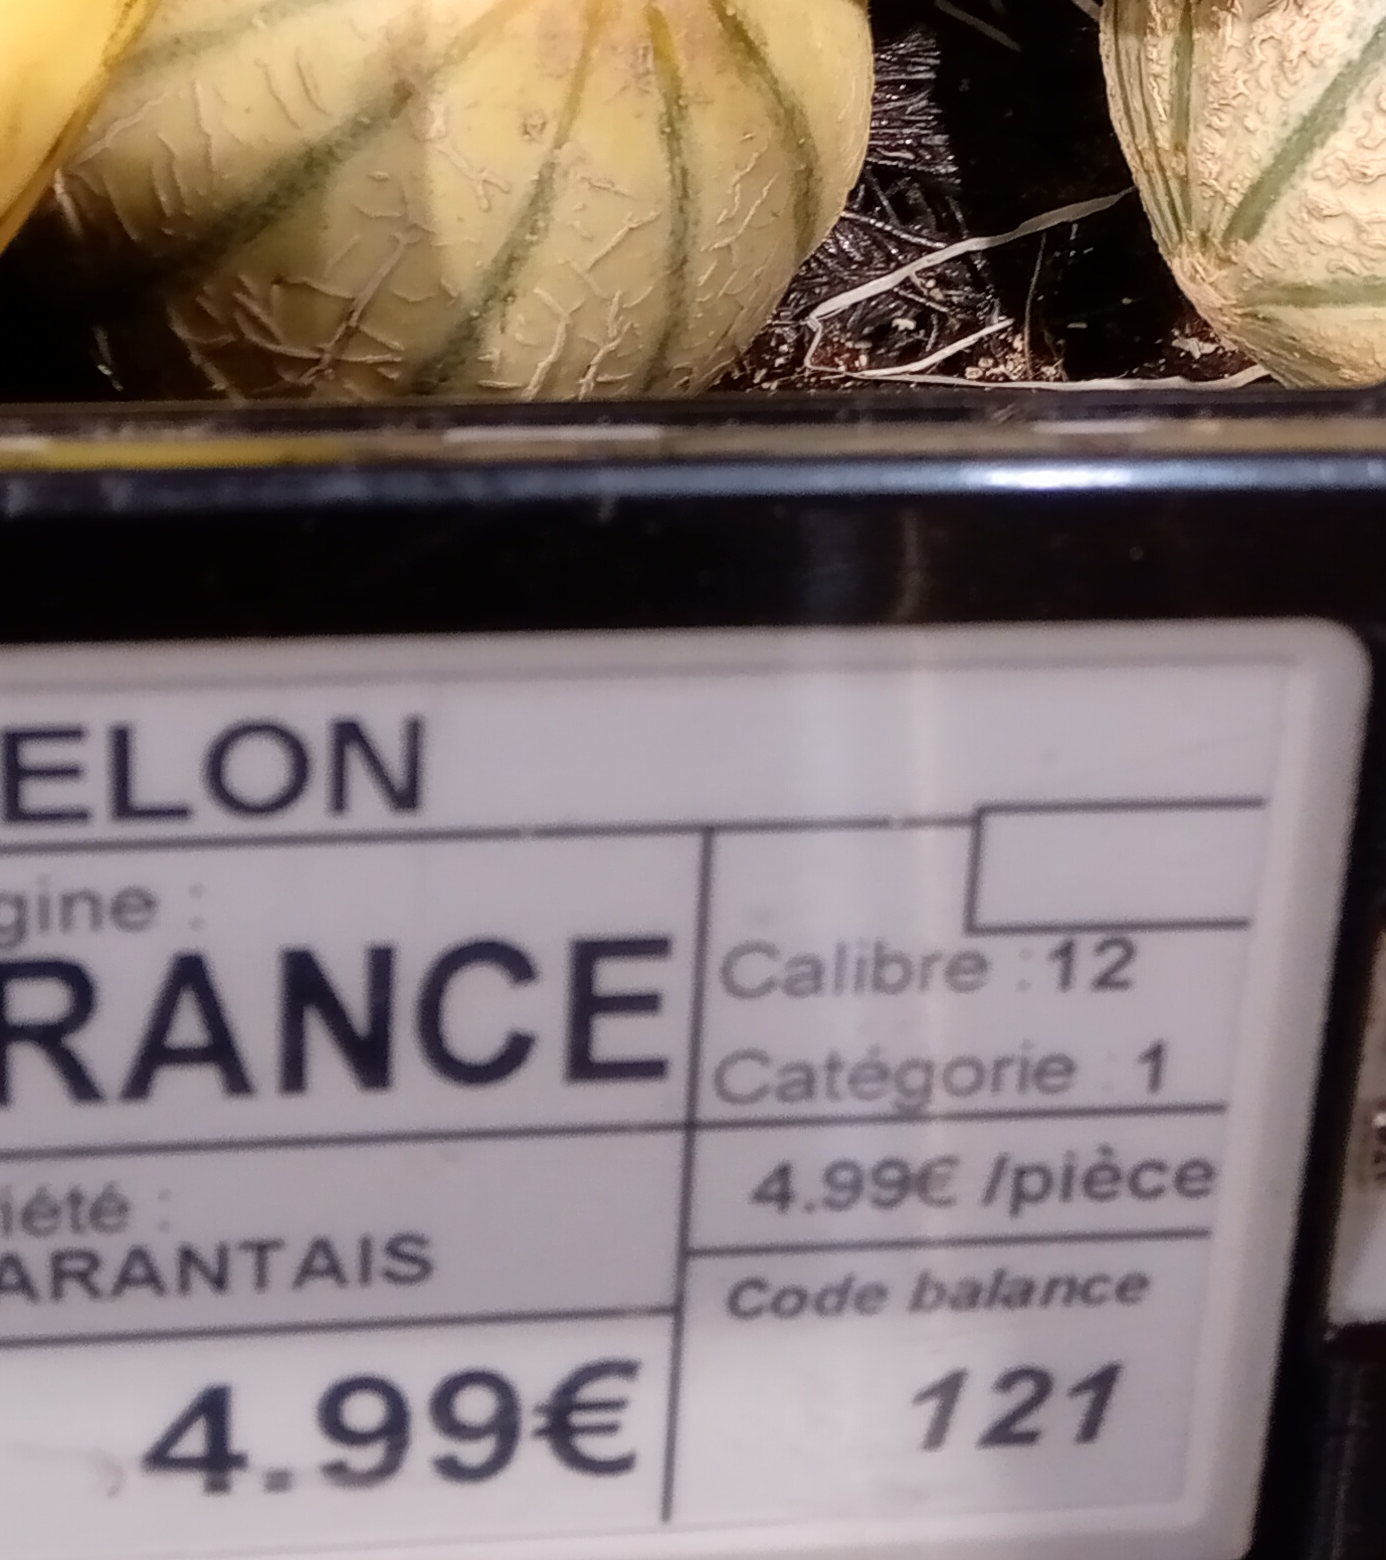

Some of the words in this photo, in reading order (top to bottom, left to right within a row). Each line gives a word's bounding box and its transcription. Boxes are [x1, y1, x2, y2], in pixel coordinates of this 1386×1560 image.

[721, 940, 989, 999] Calibre
[1049, 937, 1136, 991] 12
[713, 1039, 1075, 1113] Catégorie
[1136, 1041, 1167, 1093] 1
[751, 1154, 958, 1212] 4.99€
[981, 1146, 1214, 1216] /pièce
[726, 1274, 887, 1320] Code
[908, 1268, 1151, 1312] balance
[141, 1359, 642, 1496] 4.99€
[909, 1362, 1124, 1451] 121
